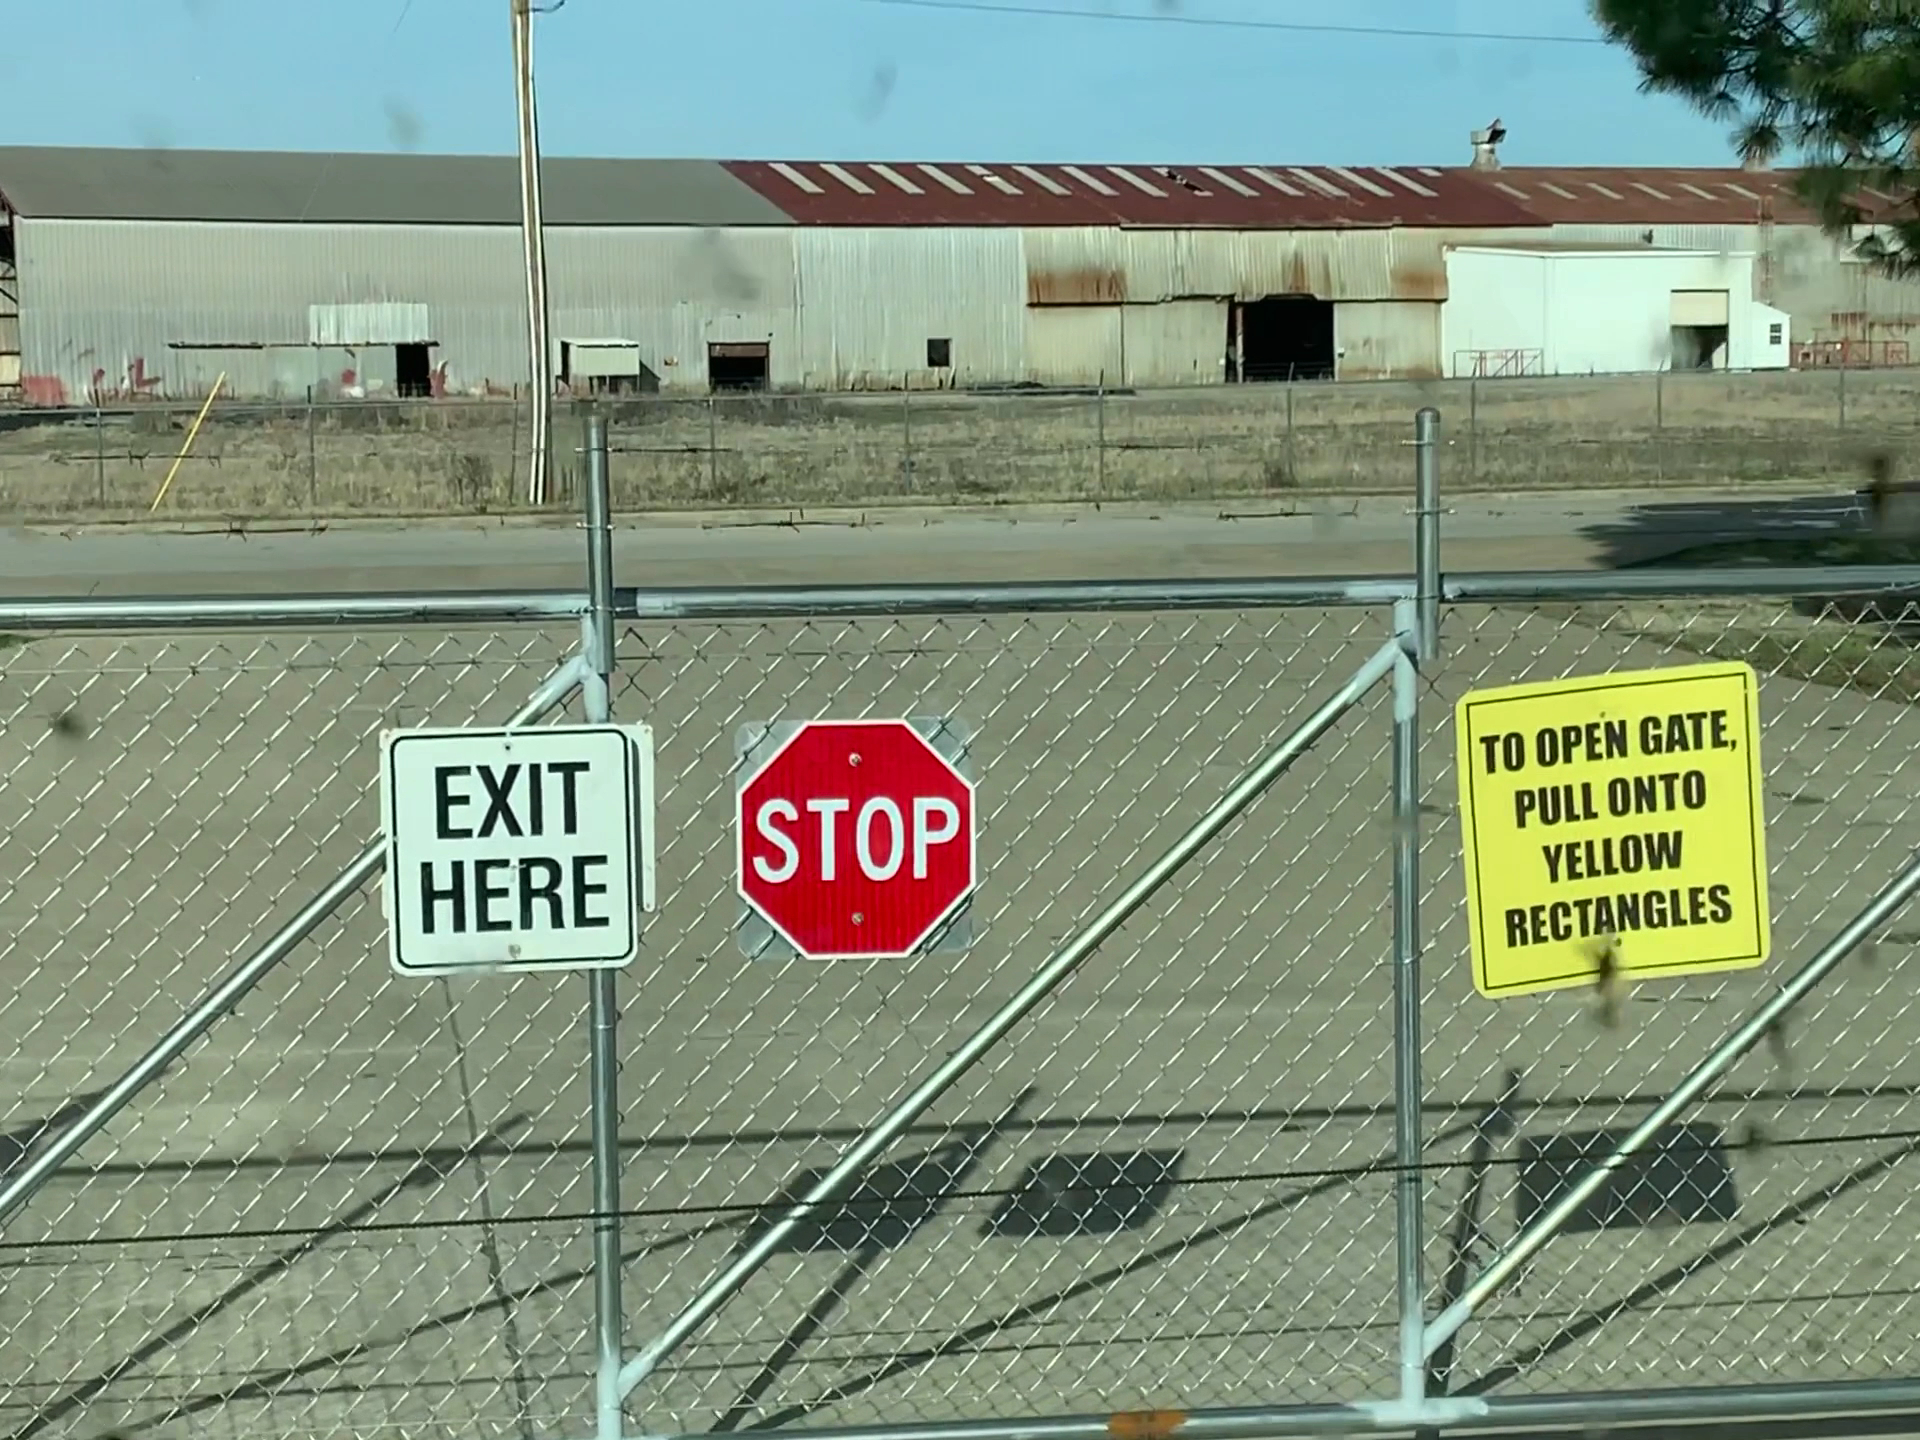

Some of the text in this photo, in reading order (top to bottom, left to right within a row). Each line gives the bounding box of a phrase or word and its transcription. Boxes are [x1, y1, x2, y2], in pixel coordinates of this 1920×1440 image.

[1480, 710, 1737, 774] TO OPEN GATE,
[436, 762, 590, 838] EXIT
[1515, 770, 1706, 829] PULL ONTO
[752, 796, 960, 884] STOP
[1542, 831, 1683, 883] YELLOW
[421, 855, 610, 933] HERE
[1505, 884, 1732, 948] RECTANGLES
